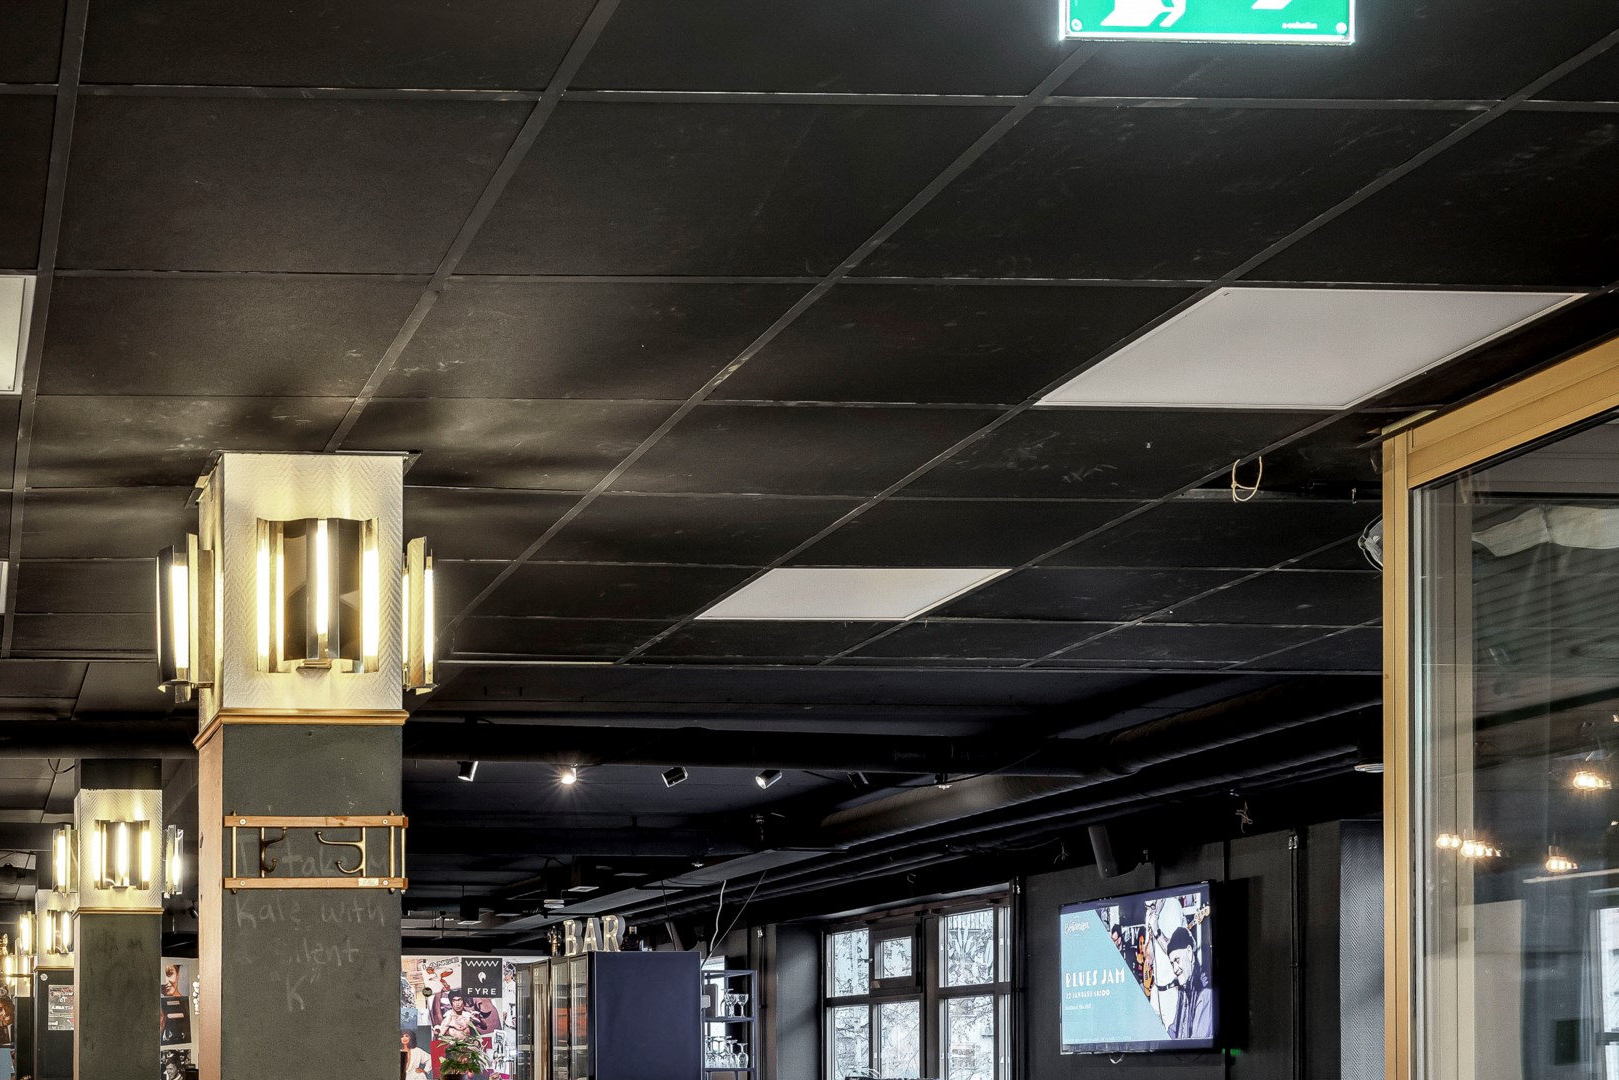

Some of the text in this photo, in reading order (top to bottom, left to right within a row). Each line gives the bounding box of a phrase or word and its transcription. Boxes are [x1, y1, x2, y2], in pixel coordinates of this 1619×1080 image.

[320, 896, 386, 927] with
[563, 914, 623, 957] BAR
[1065, 966, 1126, 988] BLUES JAM
[467, 987, 497, 995] FYRE
